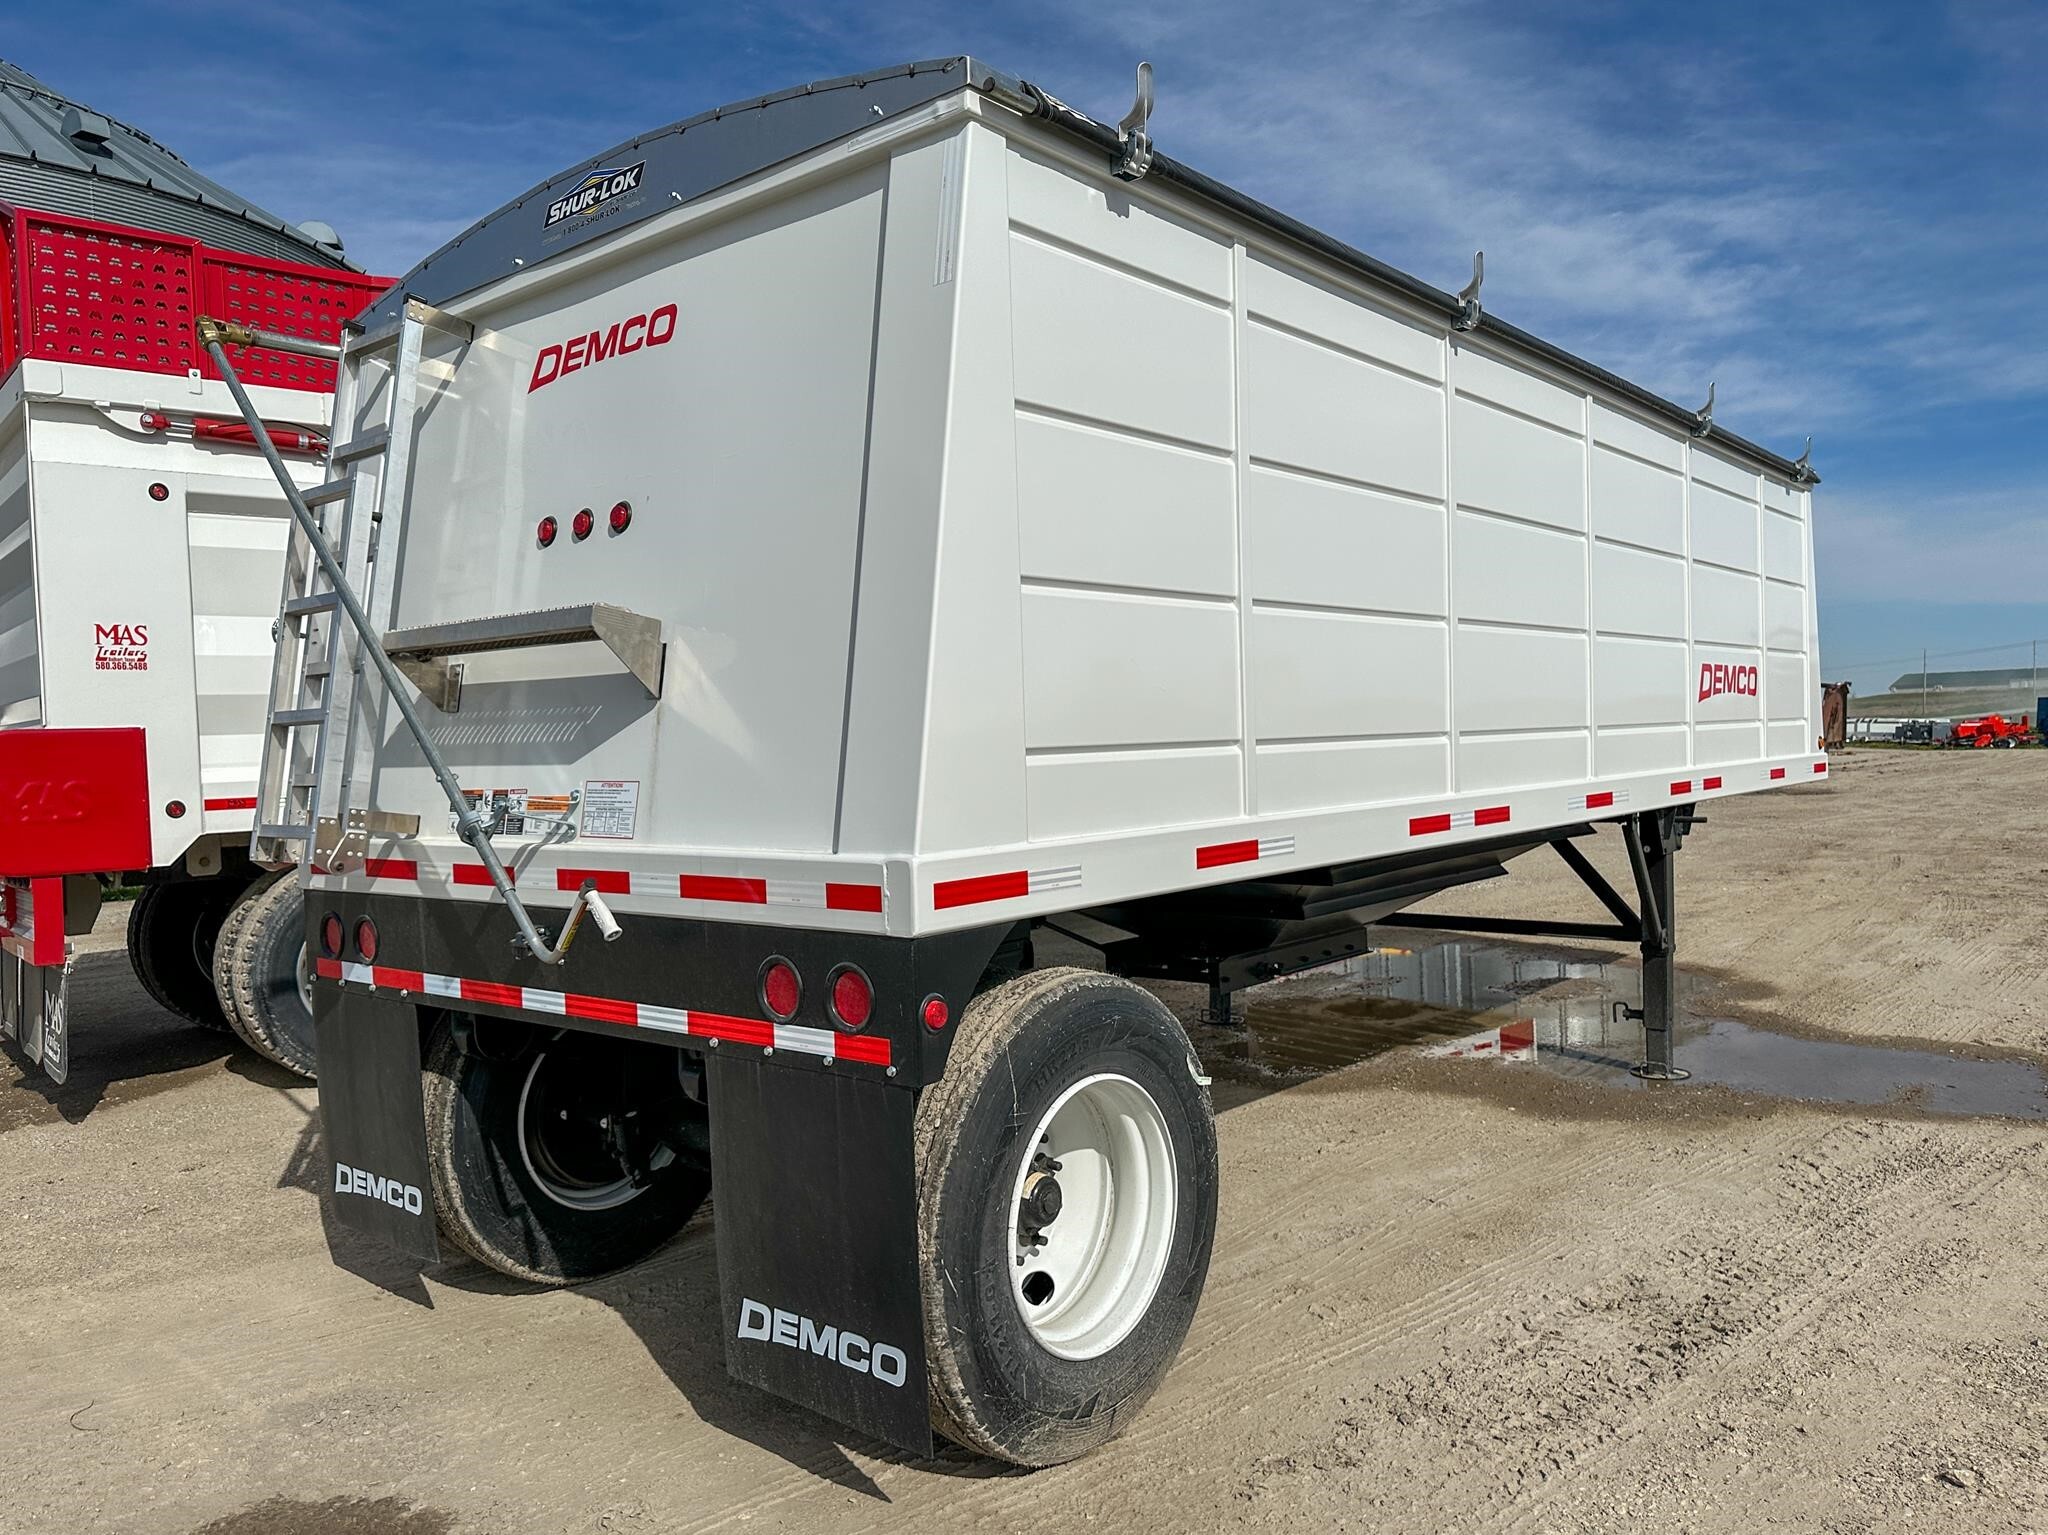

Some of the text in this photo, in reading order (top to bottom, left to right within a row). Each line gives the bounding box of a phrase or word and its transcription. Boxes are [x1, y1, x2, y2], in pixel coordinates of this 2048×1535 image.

[548, 167, 640, 225] SHUR-LOK
[527, 303, 678, 395] DEMCO
[94, 623, 148, 647] MAS
[95, 645, 148, 662] Trailers
[1697, 663, 1758, 703] DEMCO
[45, 989, 63, 1035] MAS
[335, 1162, 423, 1216] DEMCO
[737, 1297, 907, 1387] DEMCO
